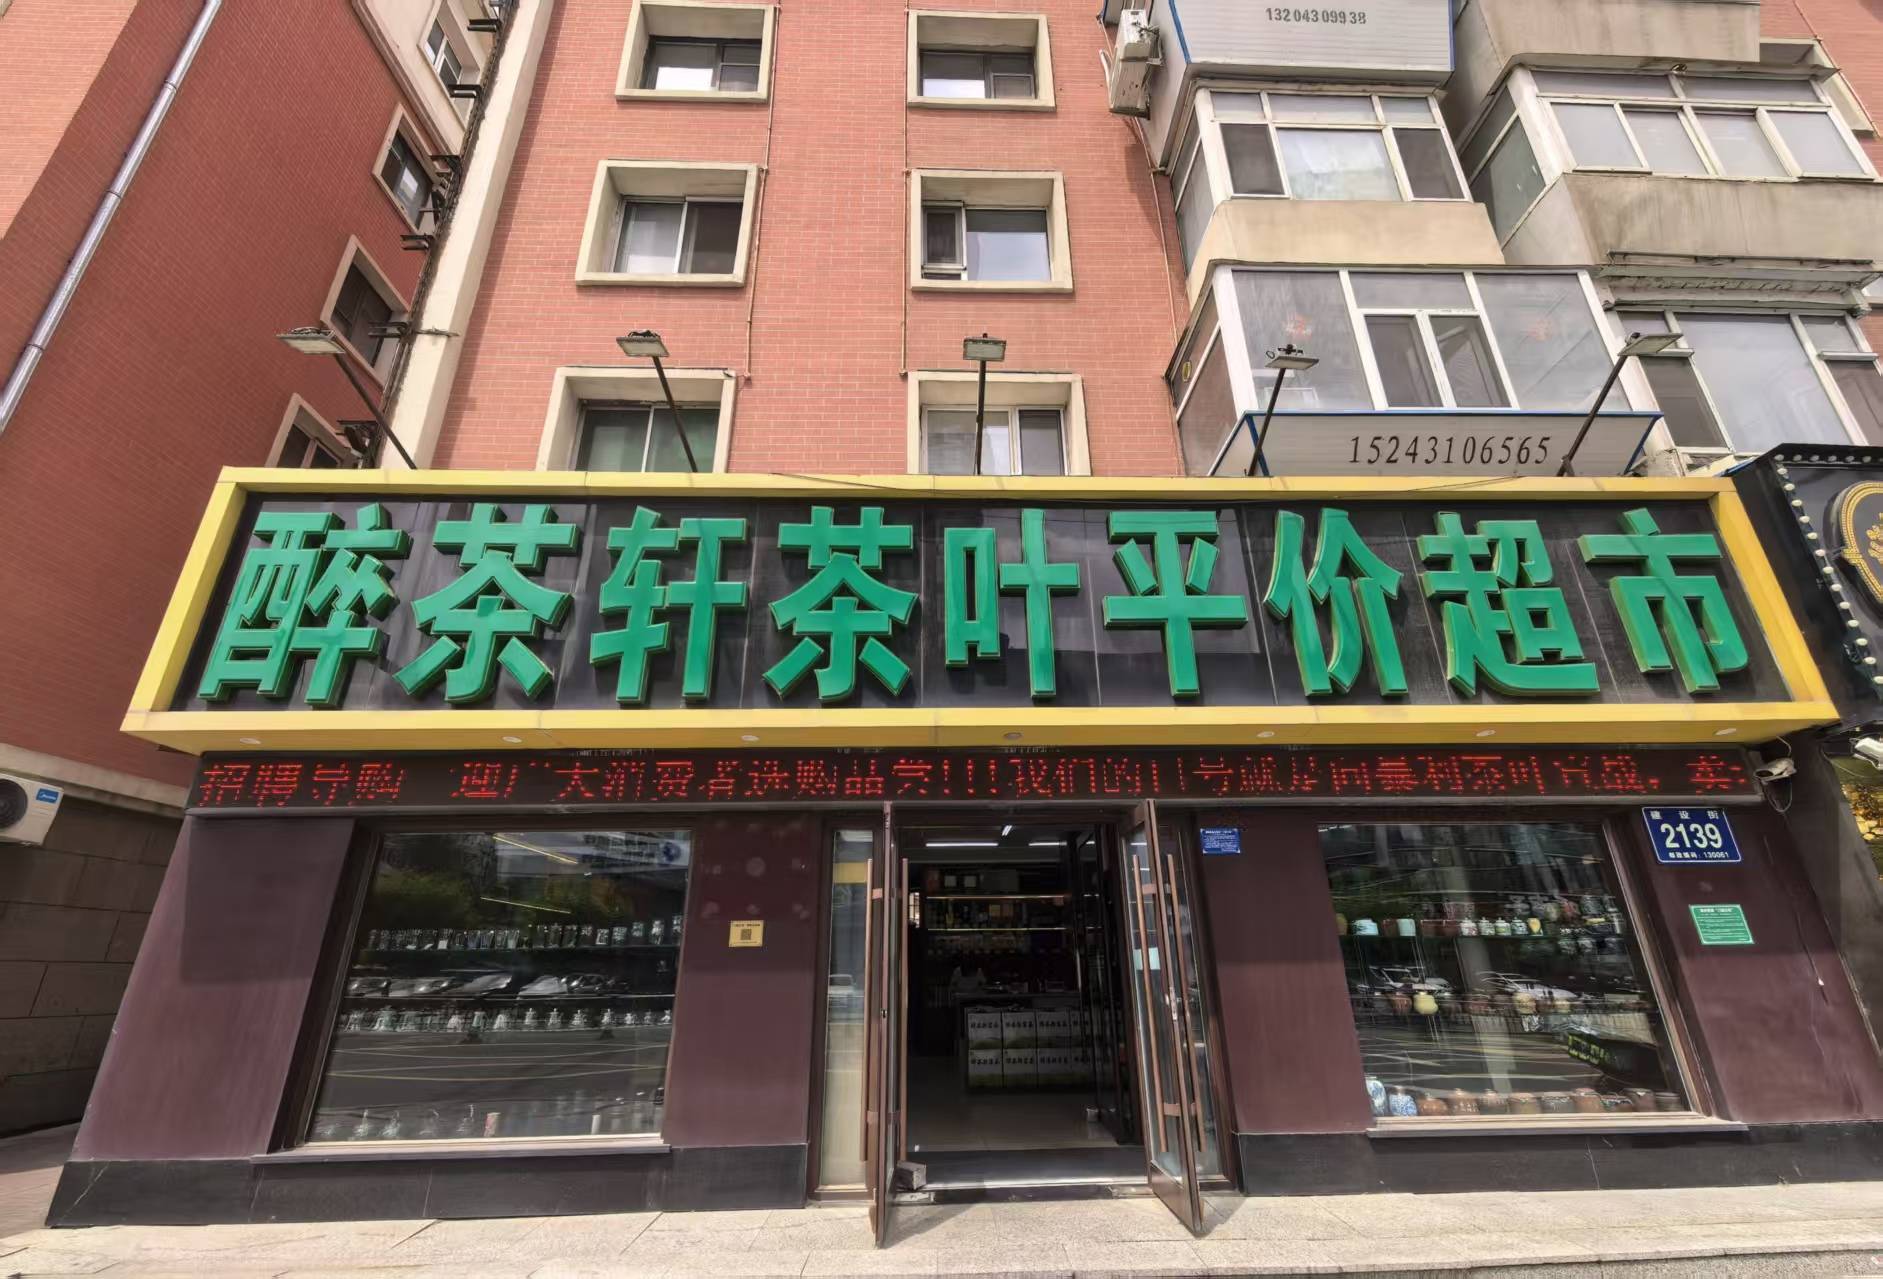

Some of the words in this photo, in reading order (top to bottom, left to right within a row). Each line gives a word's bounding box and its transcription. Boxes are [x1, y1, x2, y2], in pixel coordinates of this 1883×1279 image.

[1265, 8, 1367, 25] 13204309938
[1348, 435, 1551, 466] 15243106565
[197, 502, 1750, 704] 醉茶轩茶叶平价超市
[1660, 823, 1723, 849] 2139
